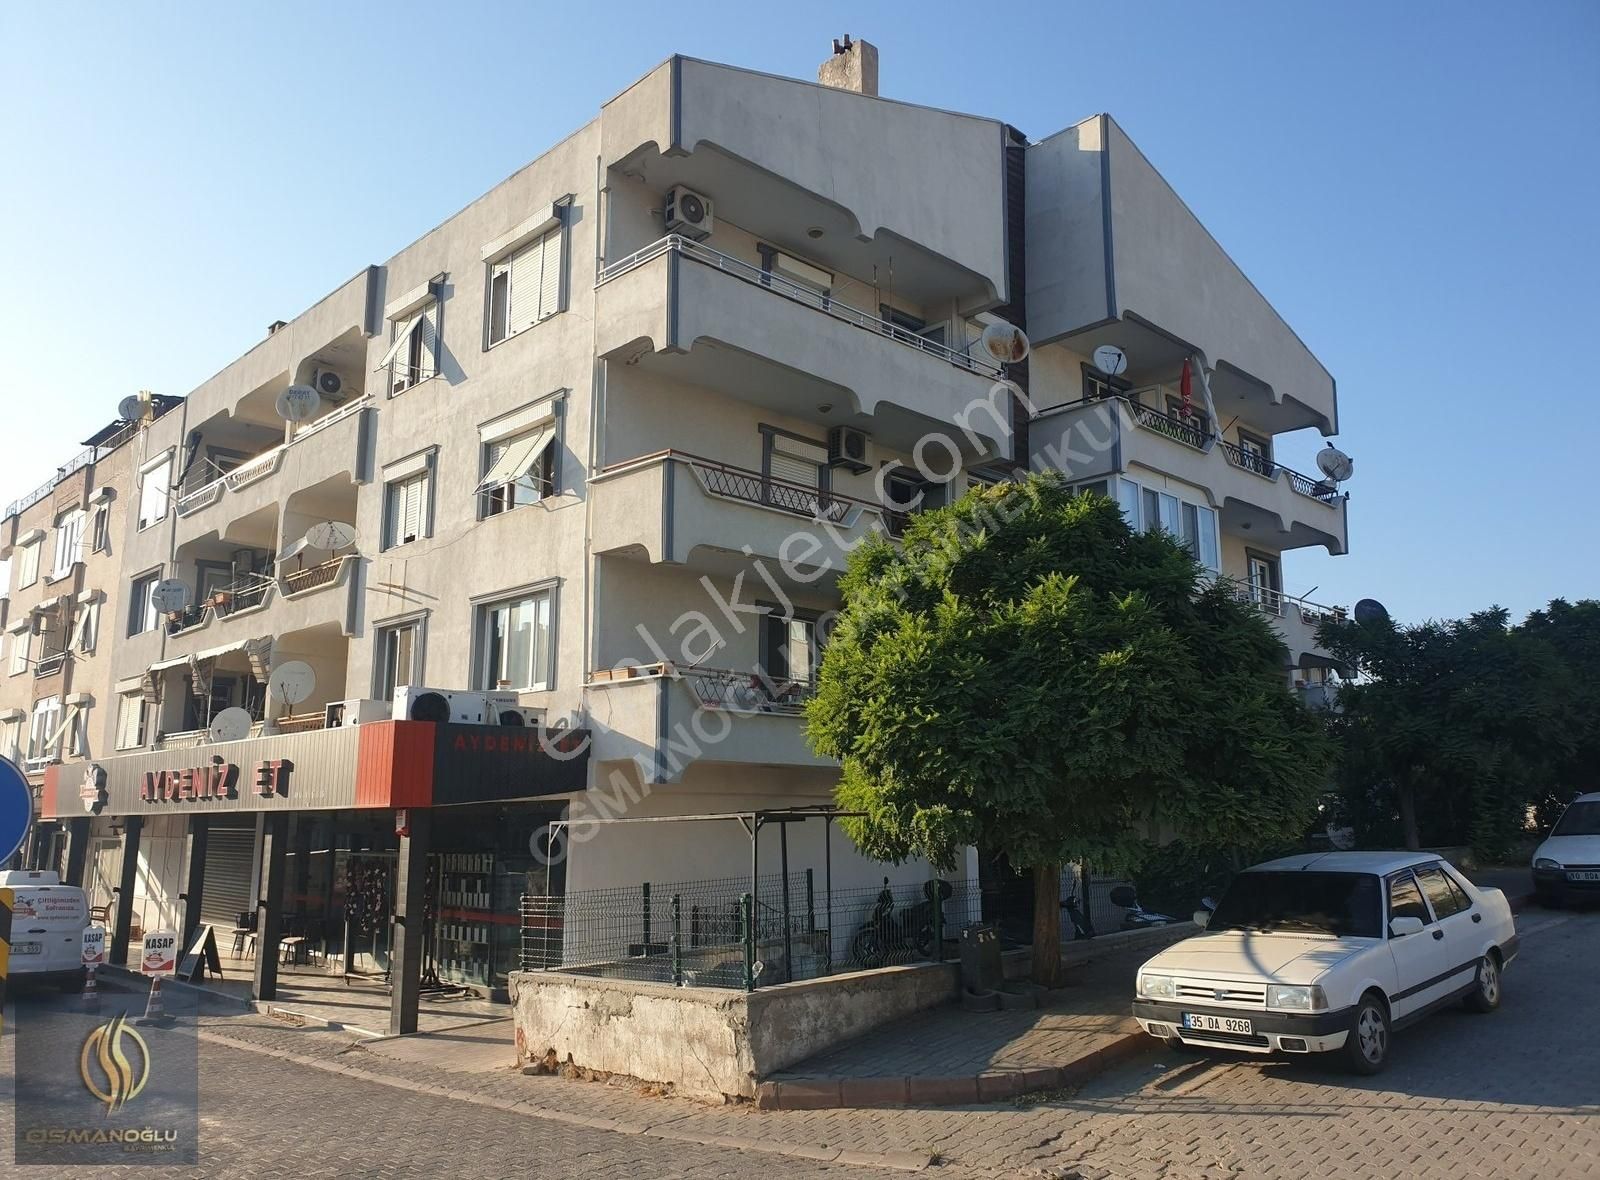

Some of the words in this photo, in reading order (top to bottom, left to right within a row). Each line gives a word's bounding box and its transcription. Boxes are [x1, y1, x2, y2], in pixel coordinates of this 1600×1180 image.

[140, 756, 230, 800] AYDENİZ
[252, 760, 283, 794] ET
[84, 933, 103, 943] KASAP
[145, 938, 174, 949] KASAP
[1191, 1015, 1203, 1028] 35
[1207, 1017, 1220, 1030] DA
[1225, 1019, 1251, 1033] 9268
